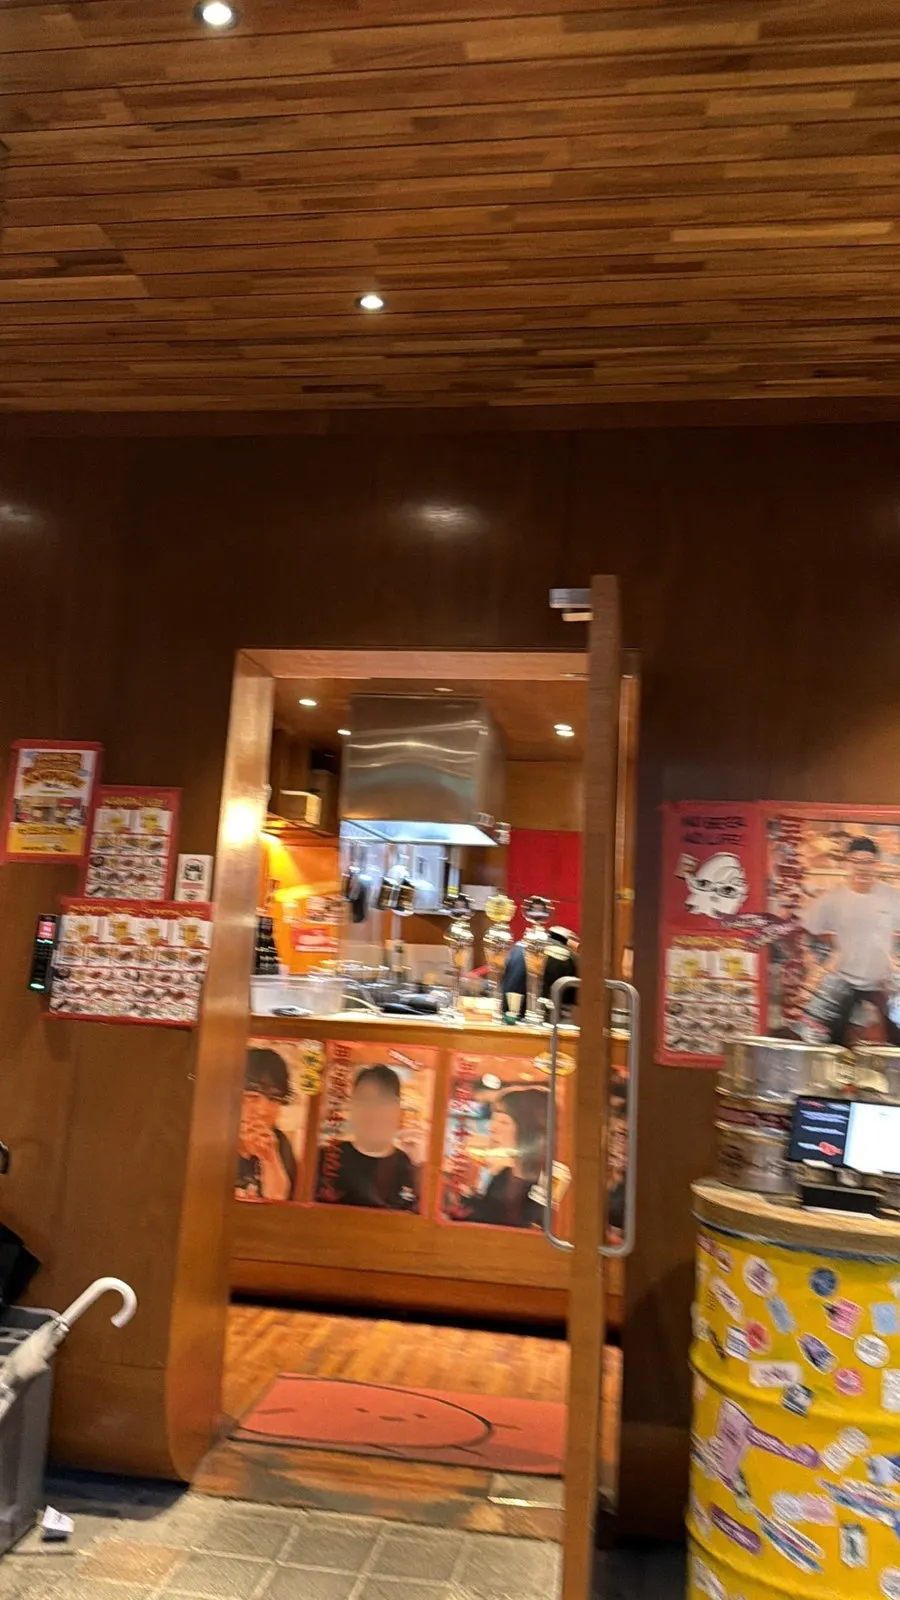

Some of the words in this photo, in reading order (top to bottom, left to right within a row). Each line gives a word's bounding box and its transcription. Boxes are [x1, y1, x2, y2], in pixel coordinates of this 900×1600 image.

[681, 816, 701, 828] NO
[703, 816, 747, 829] BEER
[705, 833, 743, 847] LIFE
